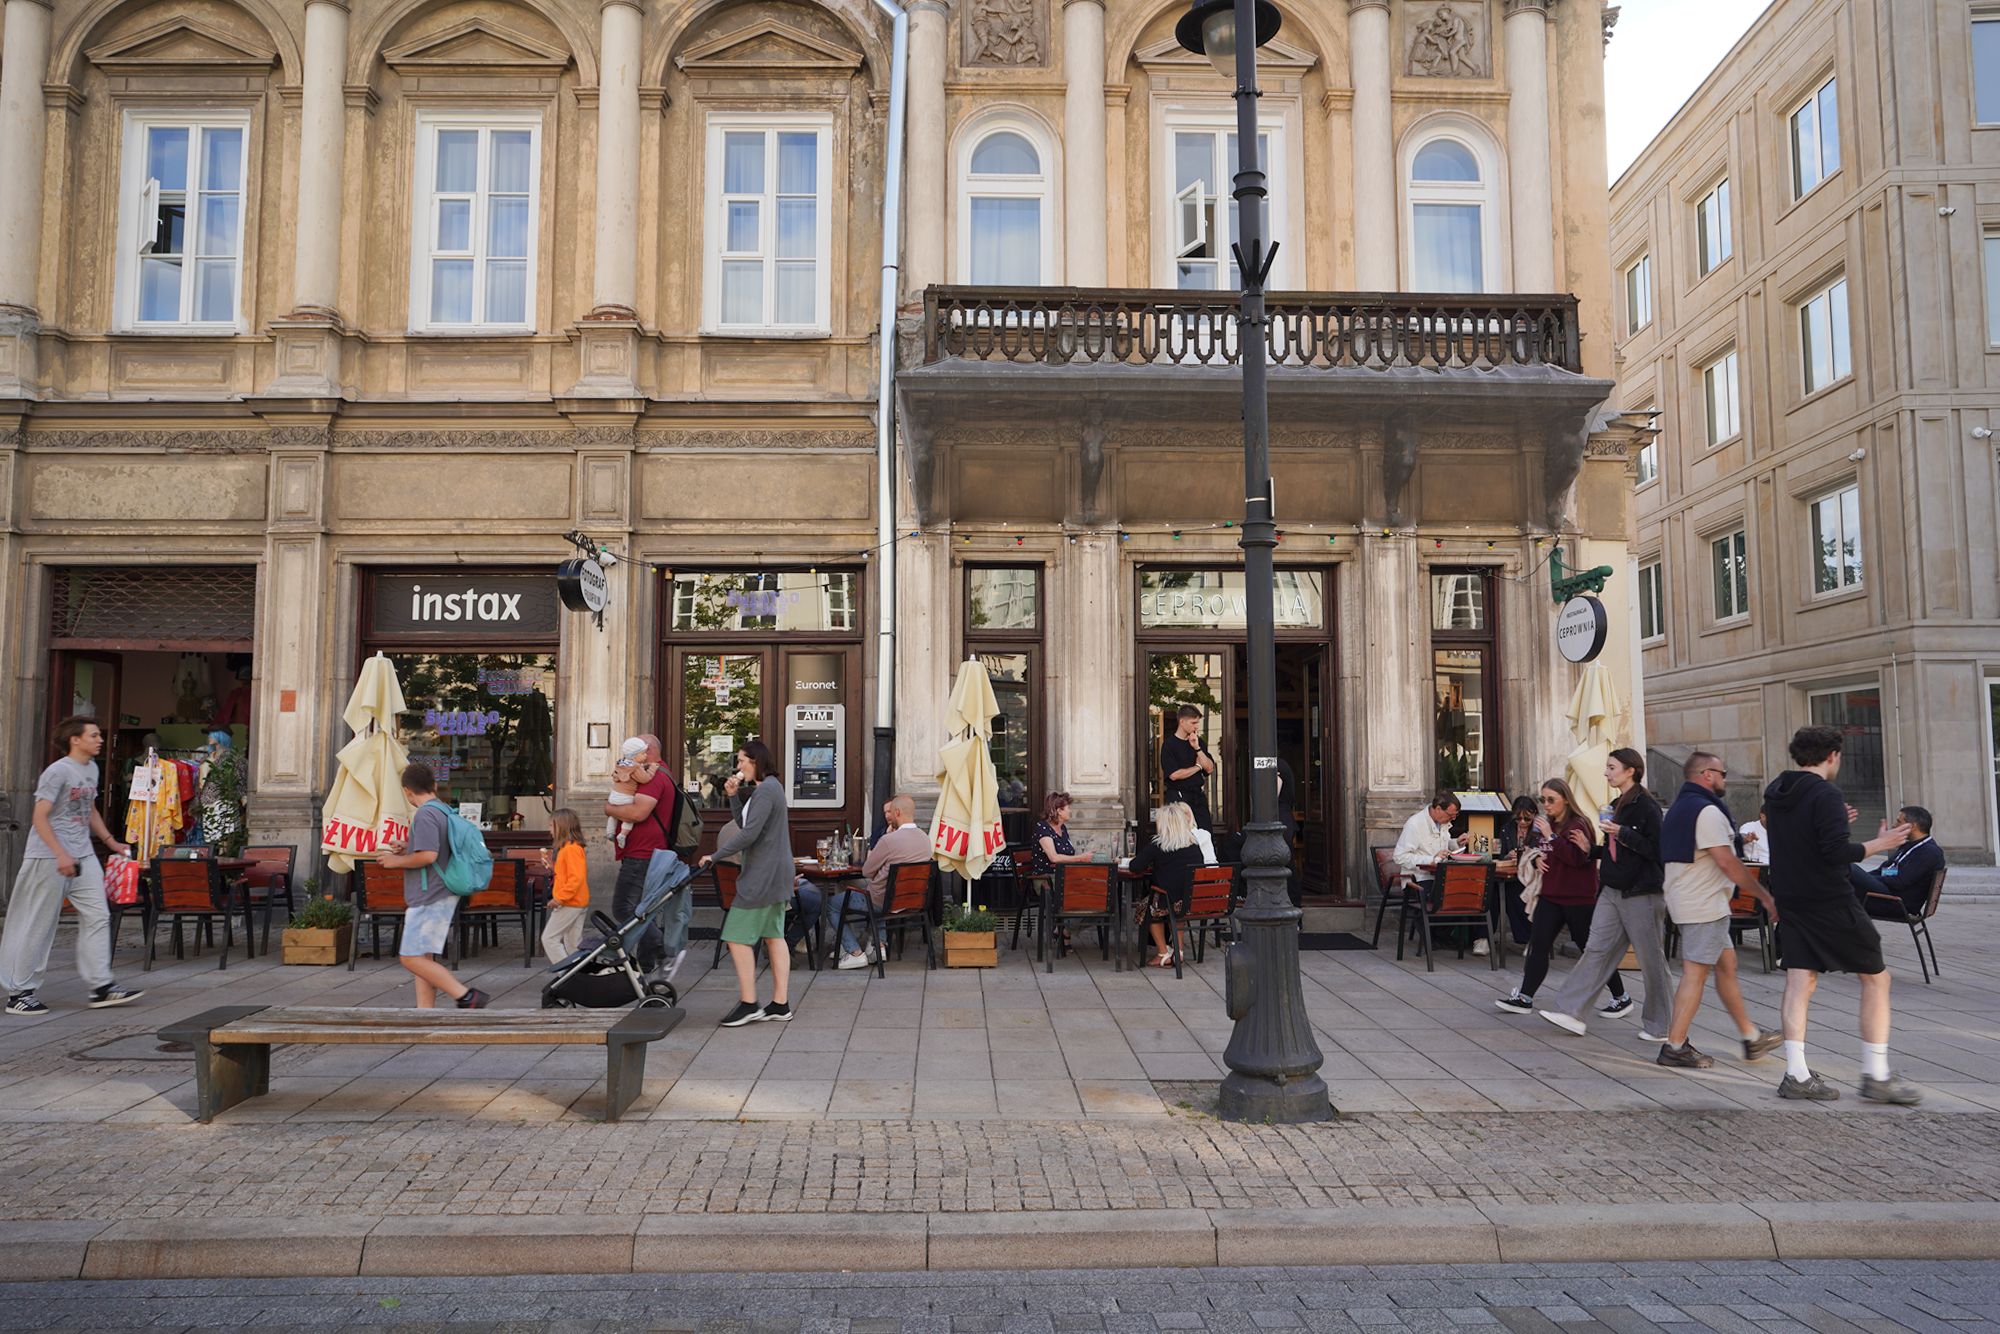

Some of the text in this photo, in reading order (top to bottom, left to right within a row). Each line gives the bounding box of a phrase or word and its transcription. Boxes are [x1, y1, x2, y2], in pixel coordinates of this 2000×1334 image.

[582, 567, 605, 590] FOTOGRAF
[412, 585, 521, 620] instax
[1141, 594, 1306, 616] CEPROWIA
[1559, 620, 1595, 639] CEPROWNIA
[795, 680, 838, 690] Euronet
[803, 711, 828, 721] ATM
